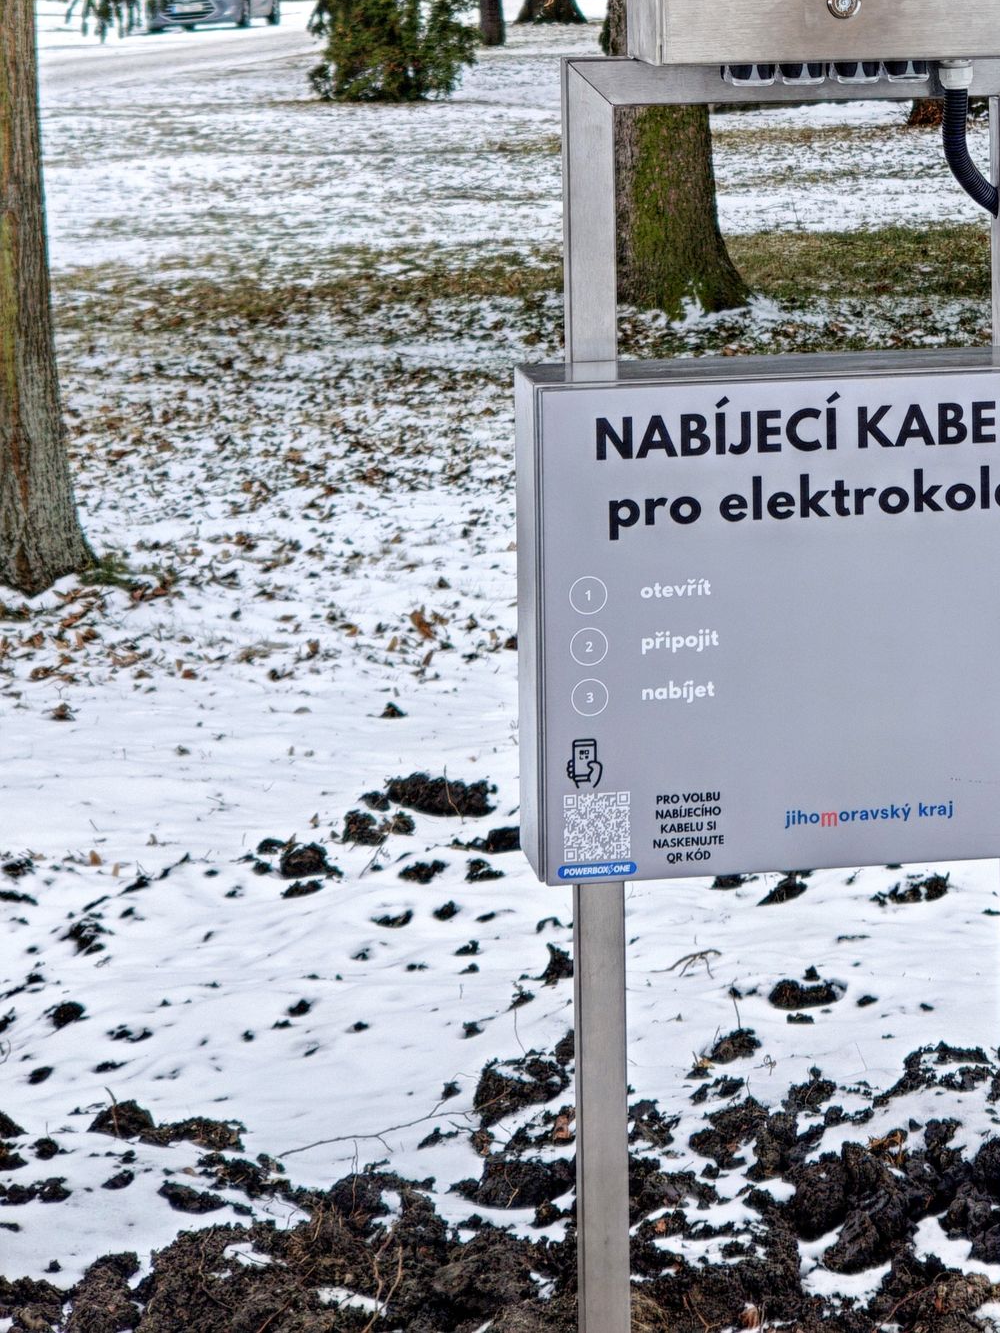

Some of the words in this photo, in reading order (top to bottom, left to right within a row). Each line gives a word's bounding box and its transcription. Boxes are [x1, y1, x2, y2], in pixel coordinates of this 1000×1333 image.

[596, 392, 838, 460] NABÍJECÍ
[608, 494, 701, 540] pro
[585, 590, 591, 601] 1
[640, 579, 711, 598] otevřít
[585, 642, 593, 652] 2
[641, 629, 719, 655] připojit
[586, 692, 594, 703] 3
[641, 680, 715, 703] nabíjet
[656, 794, 680, 805] PRO
[682, 791, 721, 803] VOLBU
[656, 804, 721, 819] NABÍJECÍHO
[785, 803, 911, 829] jihomoravský
[918, 801, 953, 819] kraj
[661, 822, 703, 834] KABELU
[707, 821, 716, 831] SI
[653, 835, 724, 848] NASKENUJTE
[667, 852, 682, 864] QR
[686, 848, 711, 861] KÓD
